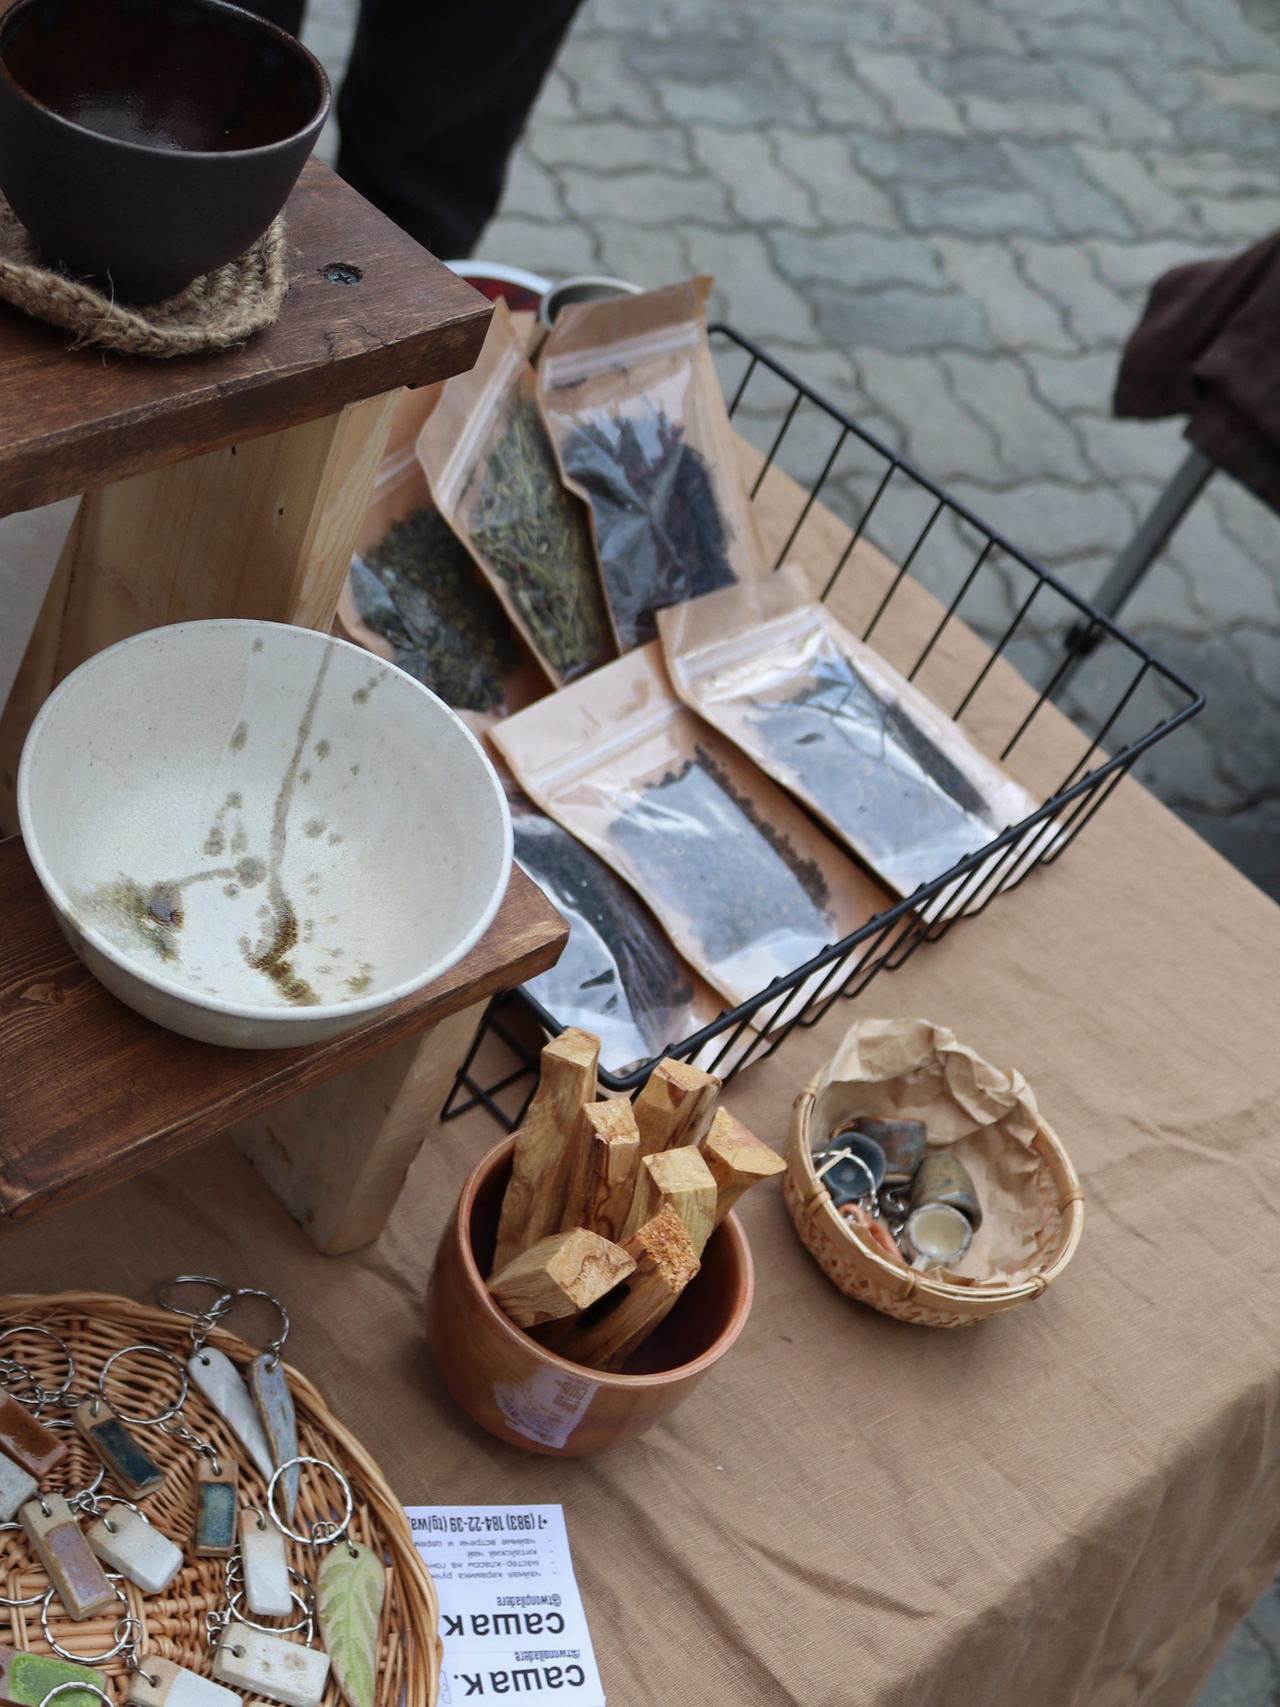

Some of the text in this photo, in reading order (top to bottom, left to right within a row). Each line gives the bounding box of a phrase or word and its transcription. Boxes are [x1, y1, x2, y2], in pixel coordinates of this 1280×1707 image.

[406, 1515, 447, 1534] (tg/wa
[450, 1516, 504, 1532] 184-22-39
[506, 1513, 535, 1530] (983)
[459, 1538, 496, 1547] встречи
[501, 1538, 536, 1548] чайные
[467, 1549, 537, 1560] китайский чай
[451, 1562, 462, 1570] на
[468, 1559, 539, 1569] мастер-классы
[458, 1570, 502, 1580] керамика
[508, 1570, 541, 1580] чайная
[442, 1612, 564, 1636] саша к
[454, 1665, 585, 1696] саша к.
